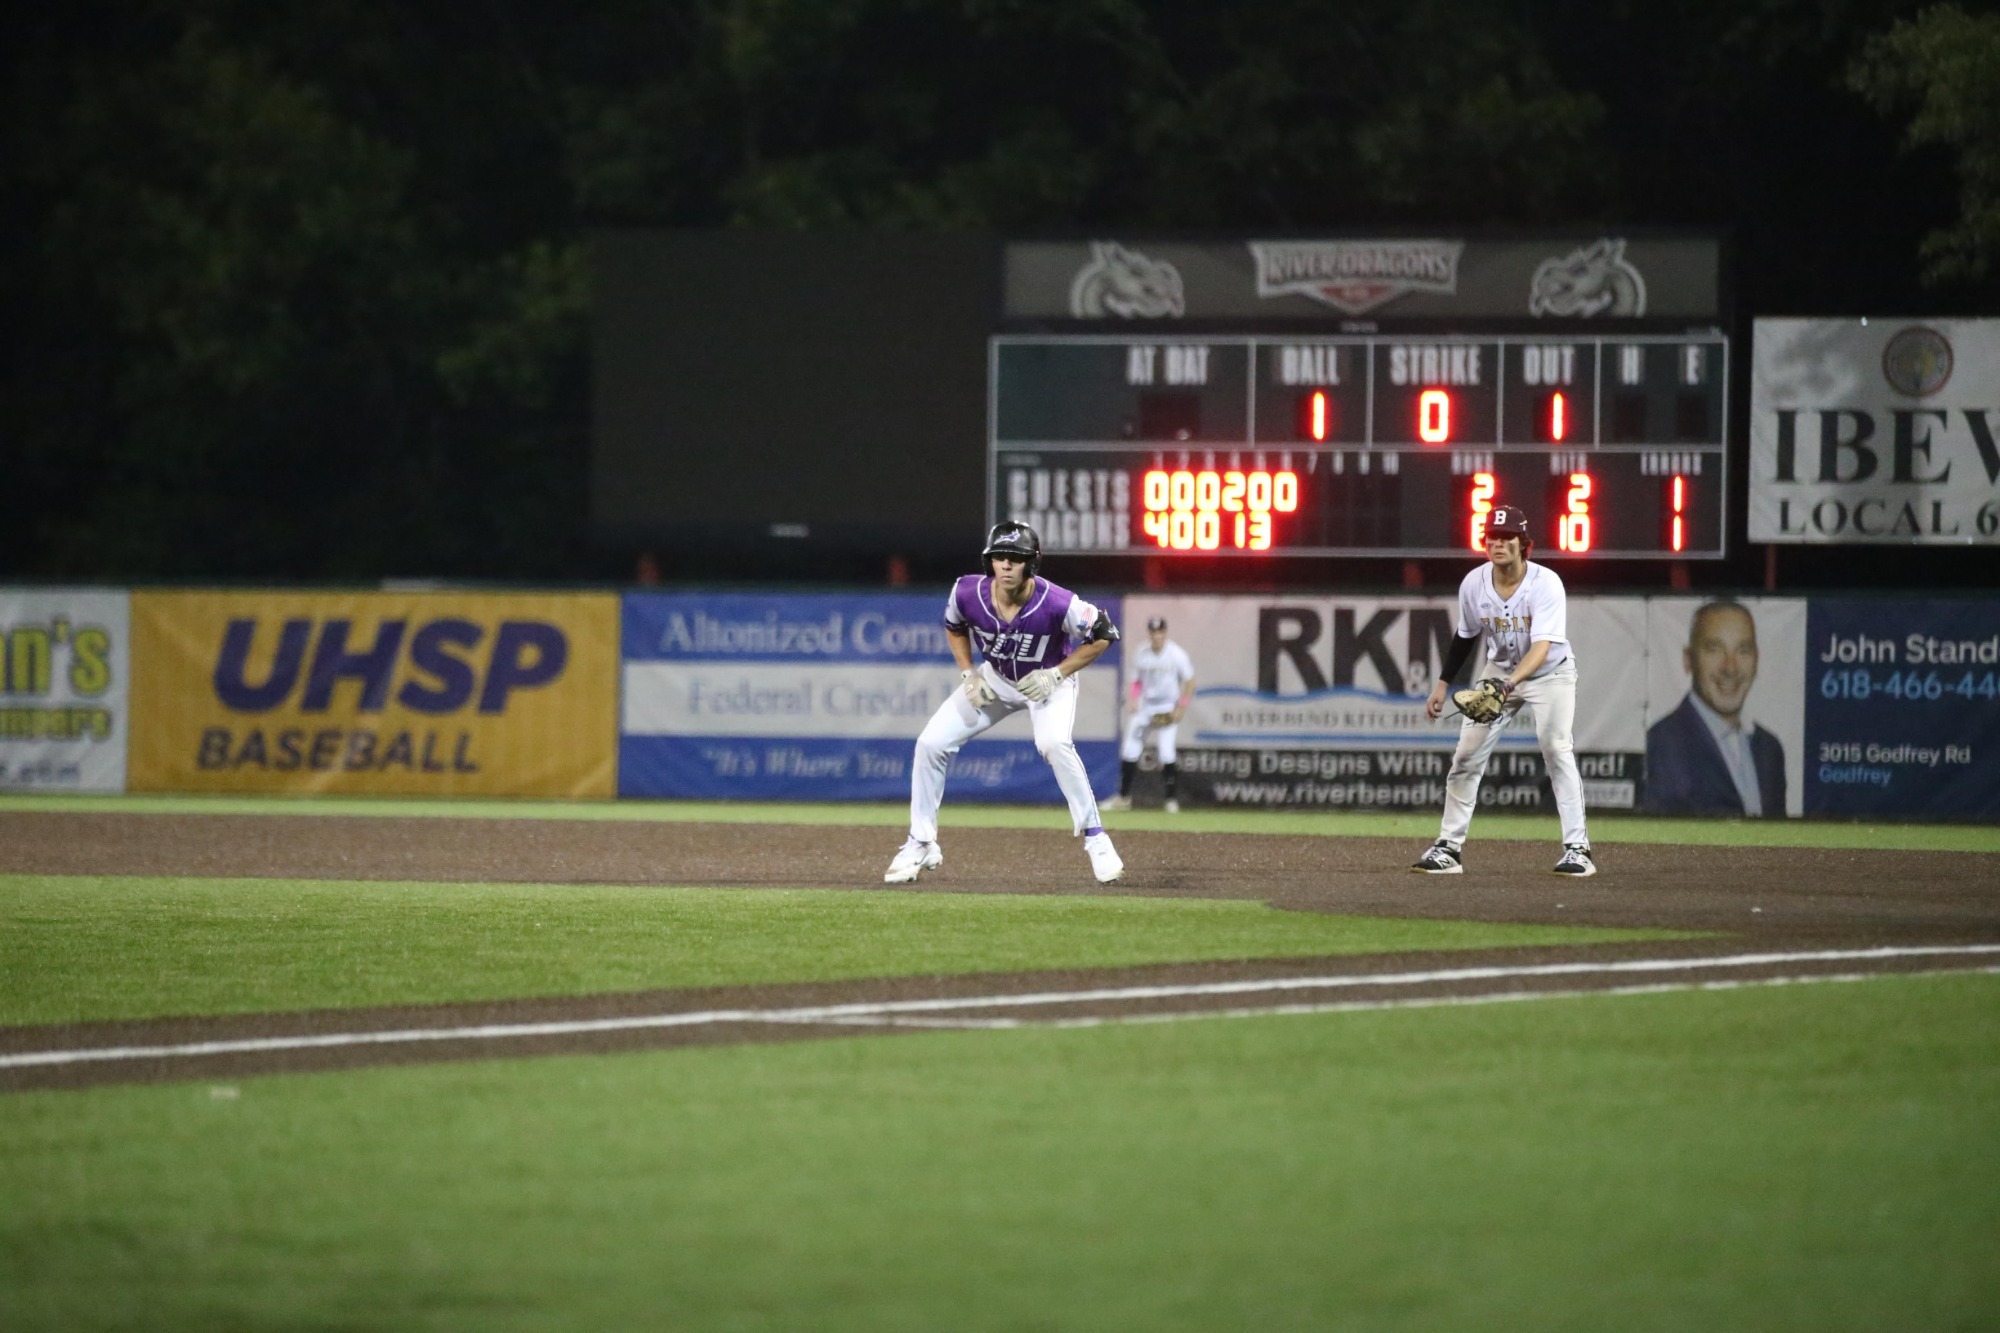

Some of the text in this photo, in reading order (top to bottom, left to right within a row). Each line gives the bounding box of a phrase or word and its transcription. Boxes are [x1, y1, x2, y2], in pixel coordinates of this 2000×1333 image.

[1281, 346, 1339, 386] BALL
[1390, 345, 1481, 386] STRIKE
[1523, 346, 1575, 386] OUT
[1312, 391, 1326, 441] 1
[1418, 389, 1450, 443] 0
[1551, 391, 1565, 441] 1
[1007, 470, 1130, 512] GUESTS
[1471, 473, 1495, 513] 2
[1567, 473, 1591, 513] 2
[1673, 475, 1683, 513] 1
[1493, 510, 1507, 525] B
[1559, 512, 1590, 552] 10
[1672, 514, 1683, 552] 1
[1777, 497, 1959, 537] LOCAL
[660, 611, 844, 653] Altonized
[1820, 632, 2000, 665] John Stand
[0, 613, 109, 693] n's
[212, 618, 569, 717] UHSP
[688, 676, 811, 717] Federal
[821, 678, 929, 718] Credit
[1820, 669, 2000, 700] 618-466-44
[1344, 710, 1424, 730] KITCHE
[198, 727, 481, 774] BASEBALL
[764, 747, 848, 778] Where
[1137, 751, 1251, 778] Ceating
[1258, 751, 1370, 778] Designs
[1377, 751, 1443, 776] With
[1509, 752, 1537, 777] In
[1818, 742, 1971, 768] 3015 Godfrey Rd
[1818, 764, 1892, 788] Godfrey
